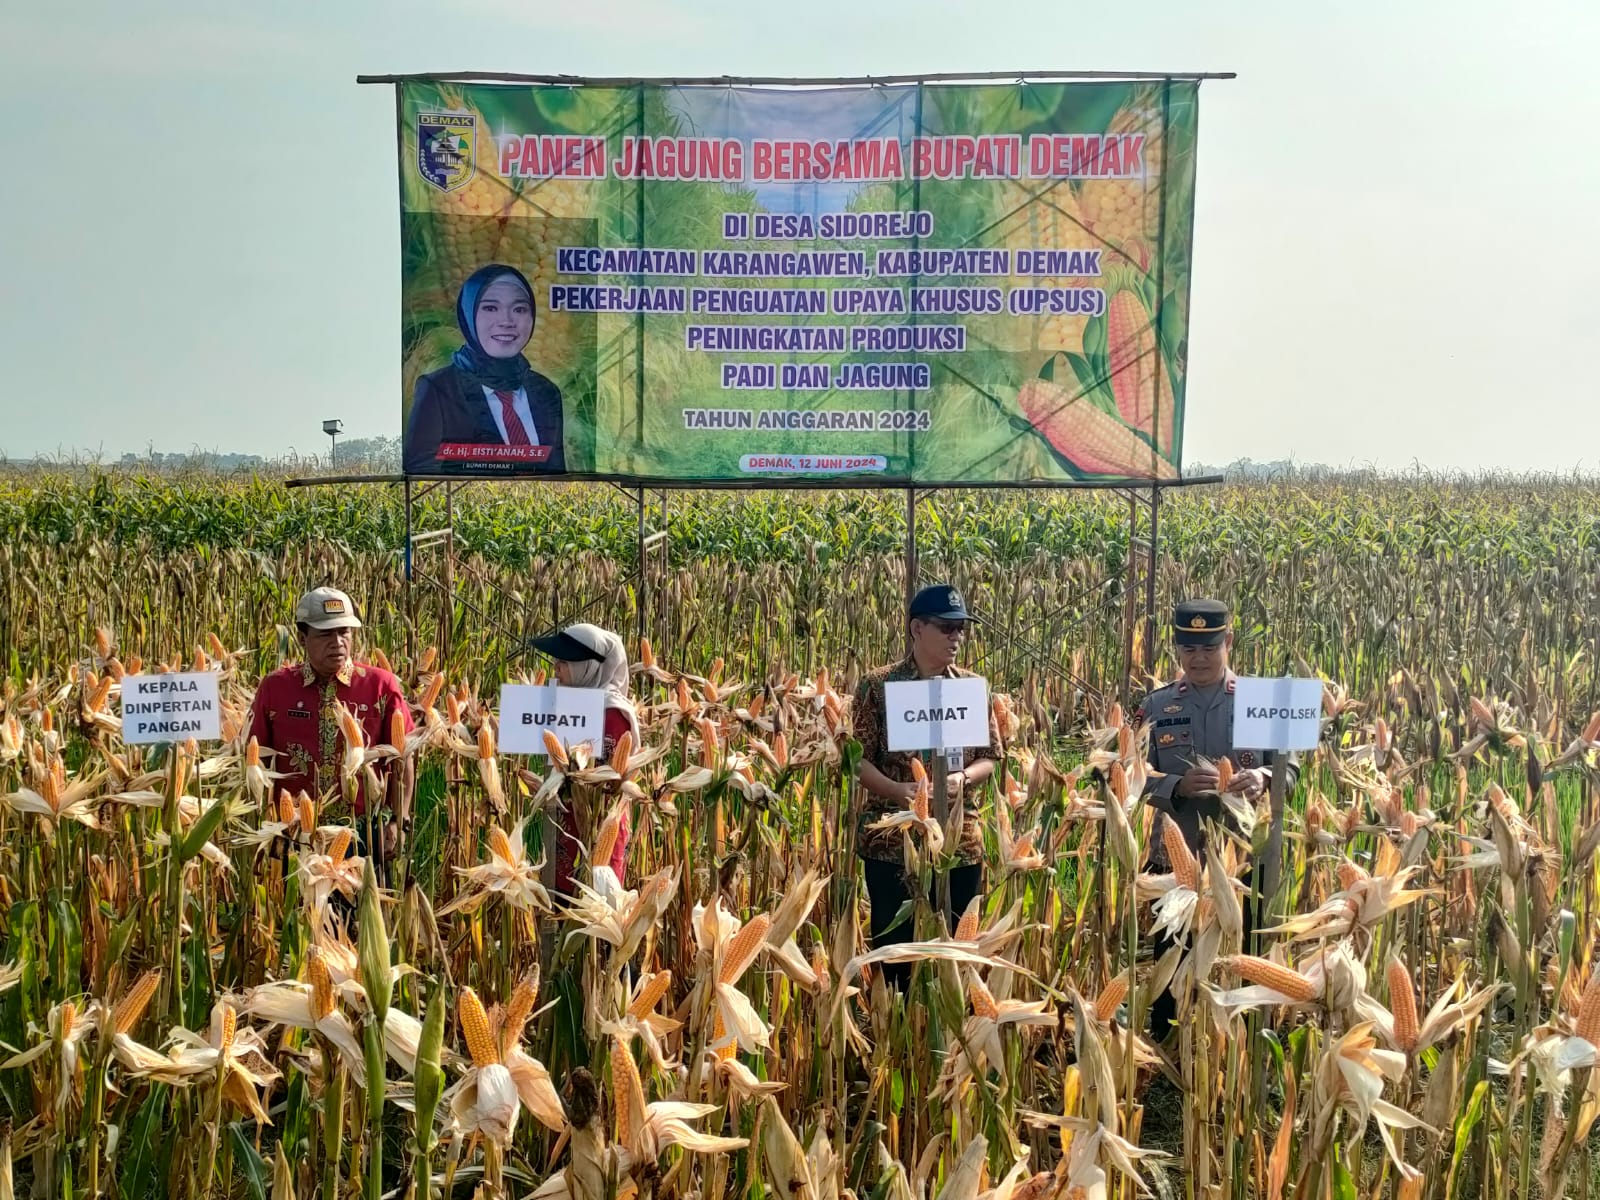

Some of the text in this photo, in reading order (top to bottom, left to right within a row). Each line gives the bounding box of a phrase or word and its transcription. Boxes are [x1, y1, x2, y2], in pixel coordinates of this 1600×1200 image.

[420, 115, 472, 126] DEMAK
[500, 133, 1146, 183] PANEN JAGUNG BERSAMA BUPATI DEMAK
[724, 212, 934, 239] DI DESA SIDOREJO
[557, 248, 1101, 278] KECAMATAN KARANGAWEN, KABUPATEN DEMAK
[550, 285, 1105, 315] PEKERJAAN PENGUATAN UPAYA KHUSUS (UPSUS)
[686, 325, 965, 351] PENINGKATAN PRODUKSI
[722, 363, 930, 389] PADI DAN JAGUNG
[682, 409, 932, 431] TAHUN ANGGARAN 2024
[443, 447, 455, 456] dr.
[457, 447, 470, 458] Hj.
[529, 449, 545, 458] S.E.
[748, 456, 878, 470] DEMAK, 12 JUNI 2024
[138, 679, 199, 694] KEPALA
[124, 698, 213, 716] DINPERTAN
[903, 705, 969, 724] CAMAT
[1246, 706, 1317, 721] KAPOLSEK
[137, 718, 202, 735] PANGAN
[521, 711, 587, 728] BUPATI
